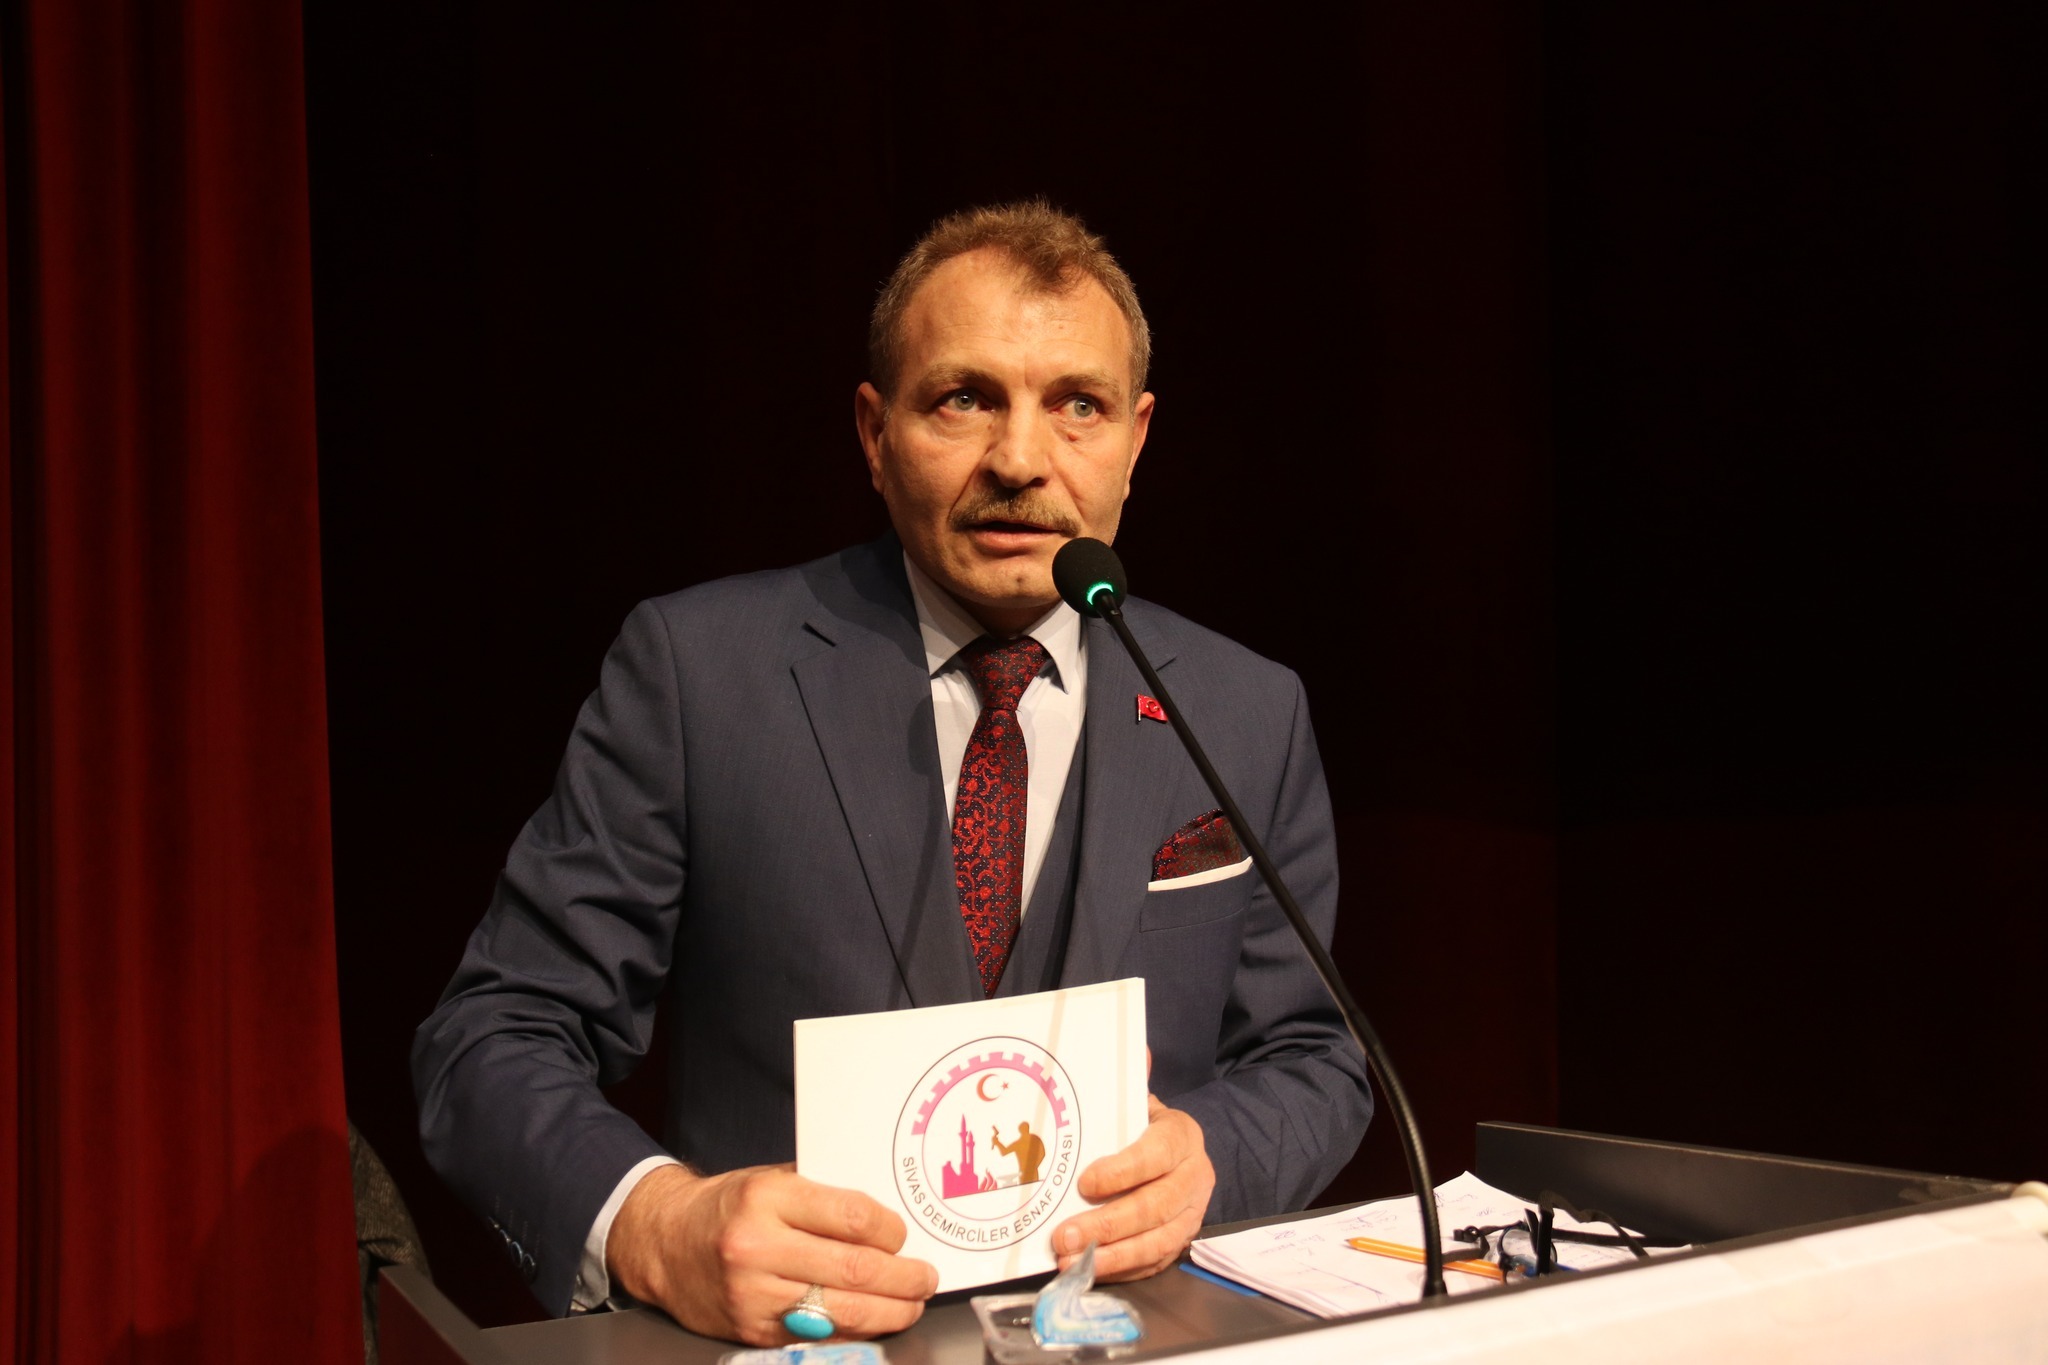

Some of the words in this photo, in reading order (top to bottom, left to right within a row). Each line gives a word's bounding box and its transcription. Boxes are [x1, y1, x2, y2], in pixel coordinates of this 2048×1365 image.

[903, 1157, 926, 1205] SİVAS
[923, 1204, 1010, 1243] DEMİRCİLER
[1014, 1190, 1054, 1233] ESNAF
[1053, 1135, 1072, 1187] ODASI
